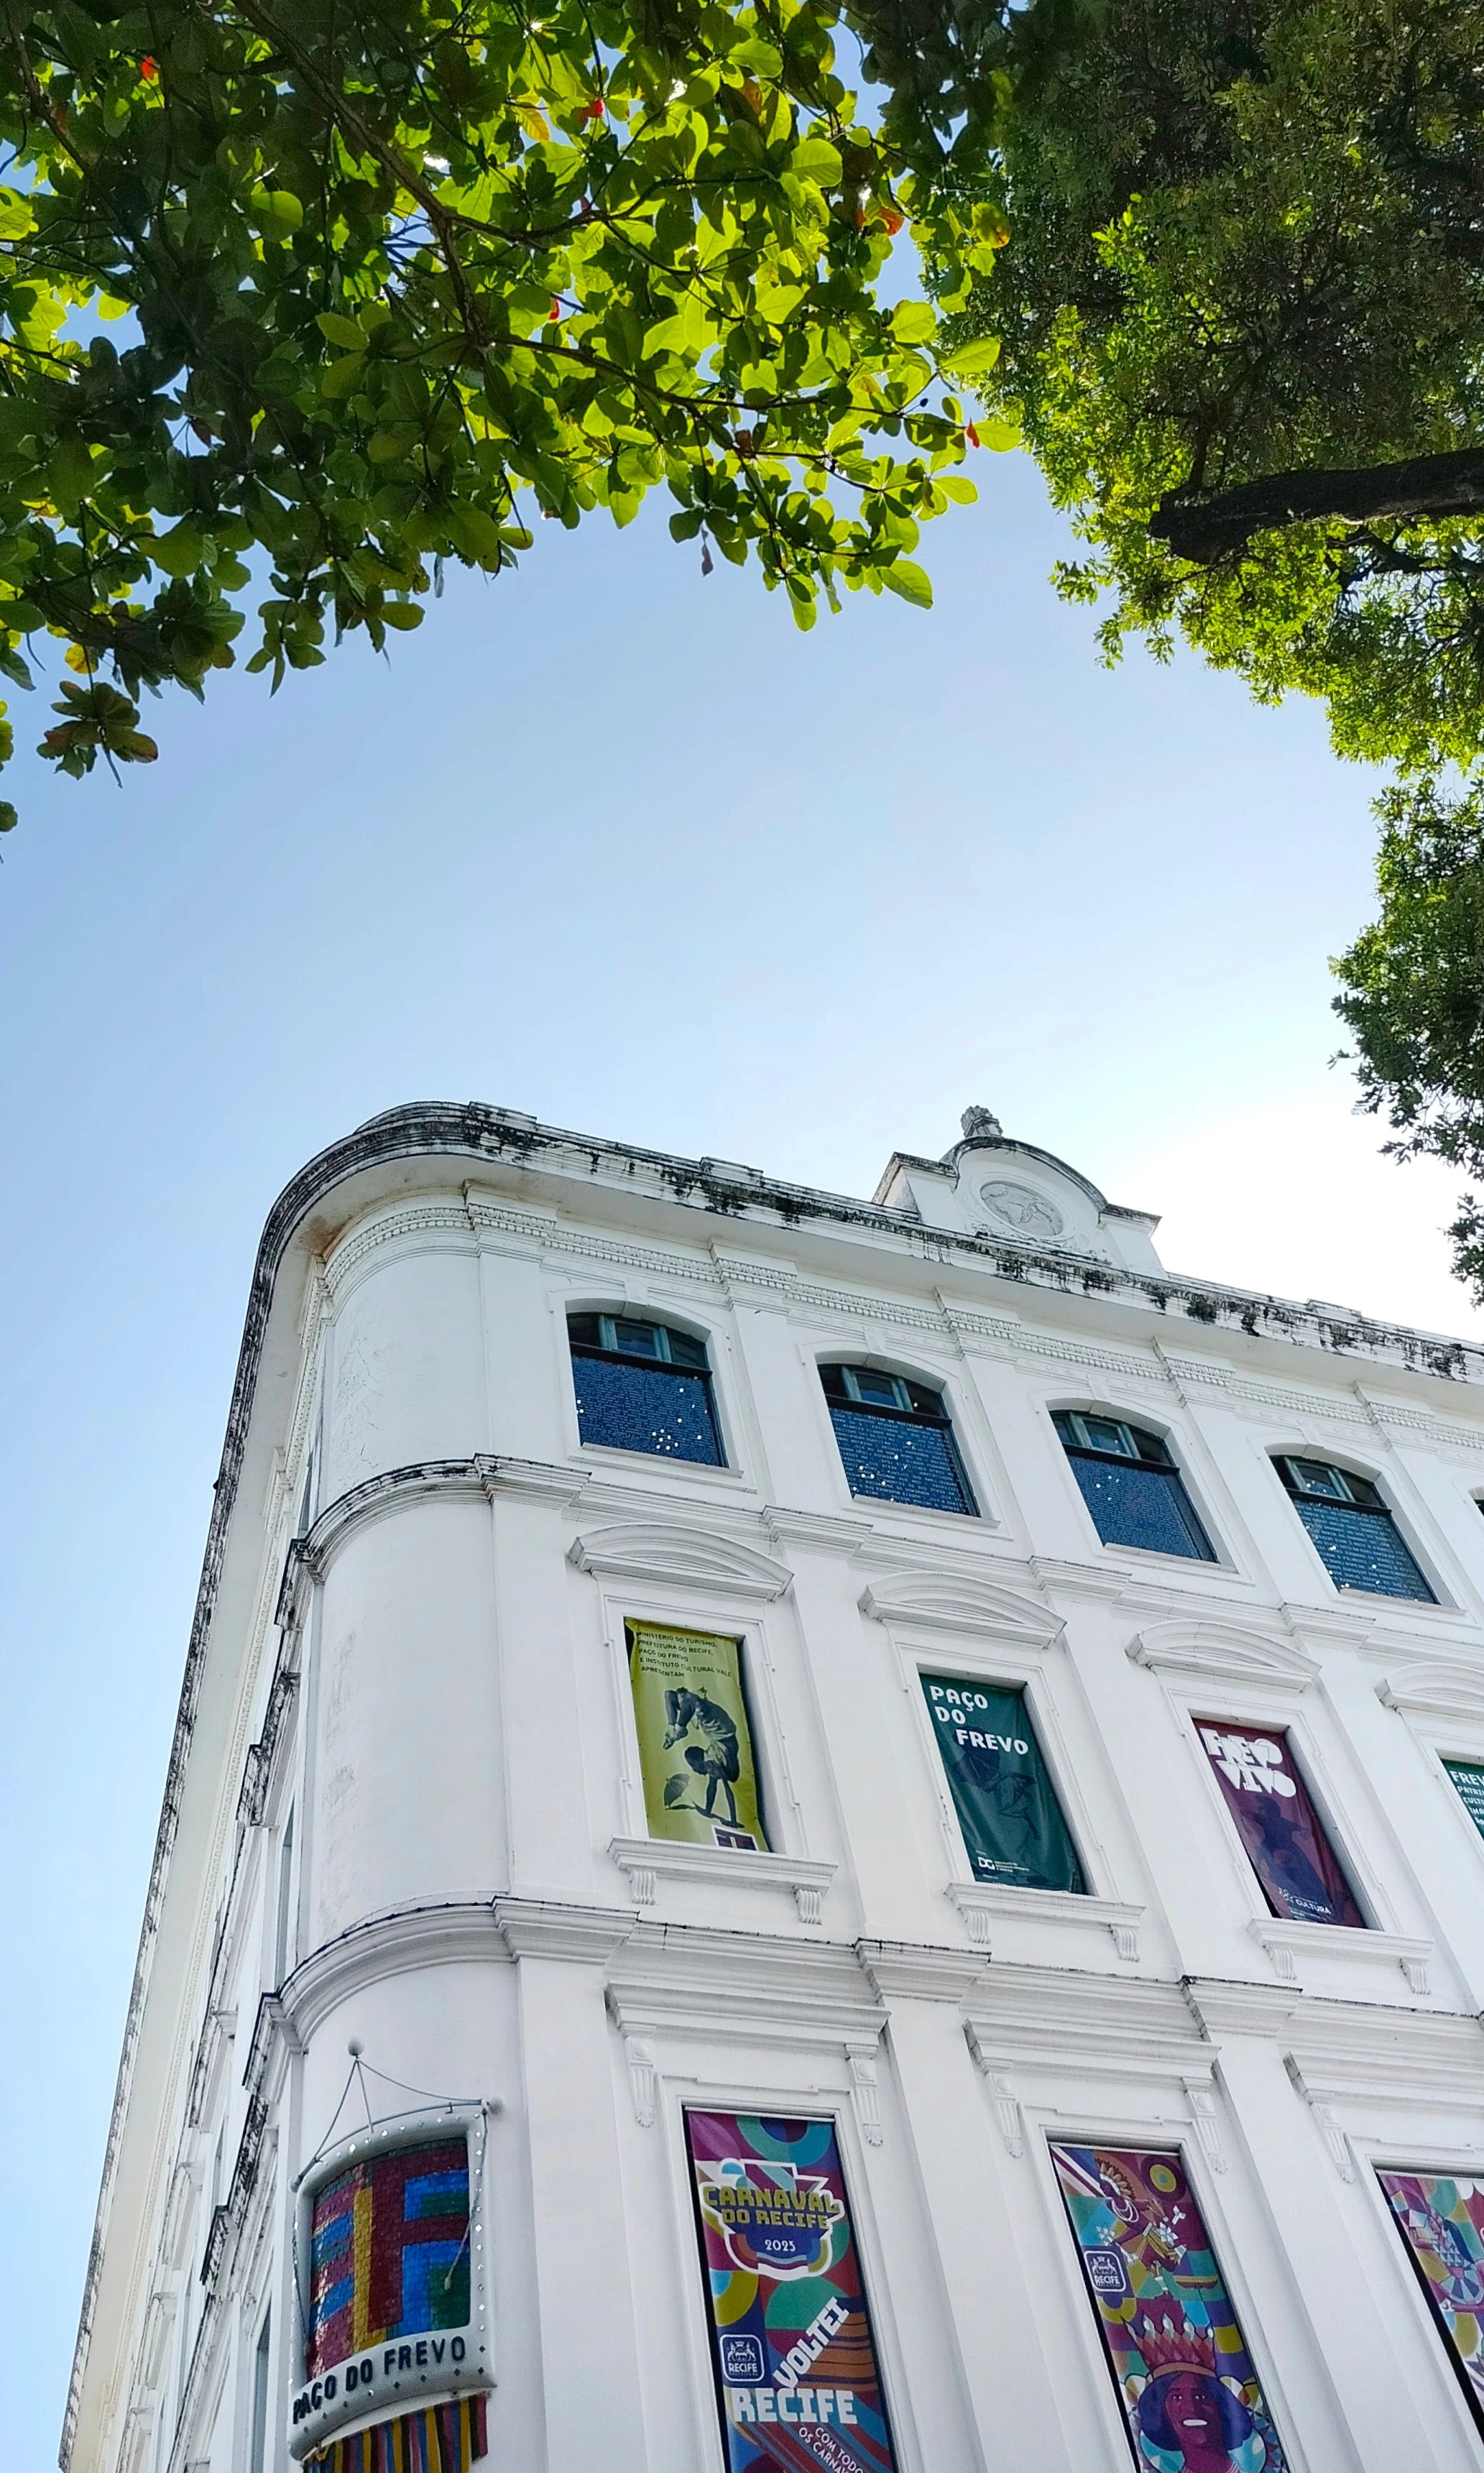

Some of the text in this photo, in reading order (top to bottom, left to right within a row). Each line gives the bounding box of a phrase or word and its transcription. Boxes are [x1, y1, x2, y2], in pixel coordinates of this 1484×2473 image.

[637, 1631, 673, 1641] MINISTÉRIO
[637, 1640, 677, 1649] PREFEITURA
[641, 1667, 684, 1677] APRESENTAM
[646, 1657, 680, 1667] INSTITUTO
[717, 1668, 732, 1677] VALE
[930, 1685, 988, 1711] PAÇO
[934, 1706, 966, 1724] DO
[956, 1729, 1028, 1754] FREVO
[1296, 1899, 1332, 1915] CULTURA
[702, 2186, 841, 2214] CARNAVAL
[721, 2209, 829, 2229] DO RECIFE
[1094, 2275, 1120, 2284] RECIFE
[773, 2296, 849, 2389] VOLTEI
[346, 2359, 373, 2392] DO
[384, 2336, 466, 2375] FREVO
[729, 2362, 758, 2372] RECIFE
[731, 2387, 857, 2424] RECIFE
[799, 2427, 814, 2444] OS
[815, 2427, 837, 2451] COM
